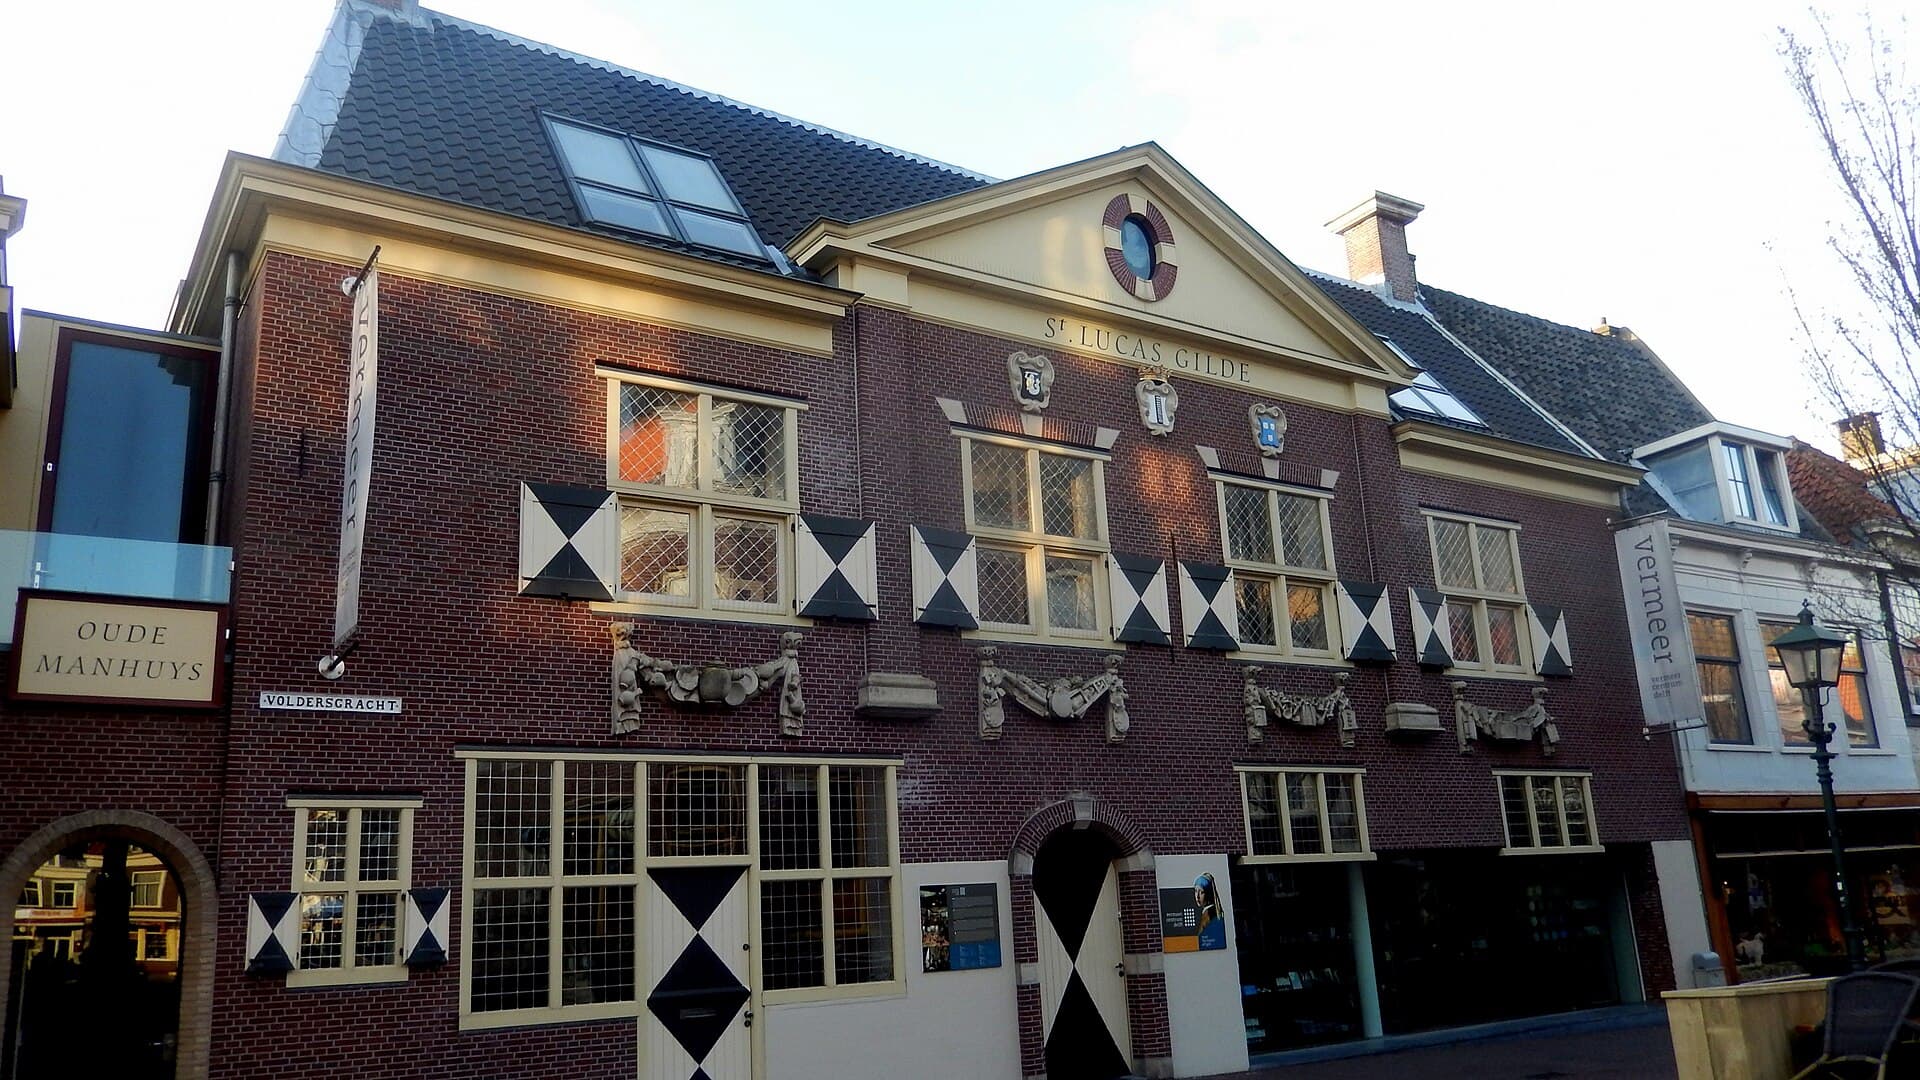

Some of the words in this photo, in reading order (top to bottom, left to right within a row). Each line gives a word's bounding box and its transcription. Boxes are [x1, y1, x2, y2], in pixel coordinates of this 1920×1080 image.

[1080, 325, 1162, 363] LUCAS
[1175, 348, 1250, 383] GILDE
[1633, 534, 1673, 664] vermeer
[77, 620, 168, 645] OUDE
[35, 653, 204, 682] MANHUYS
[266, 694, 397, 711] VOLDERSGRACHT
